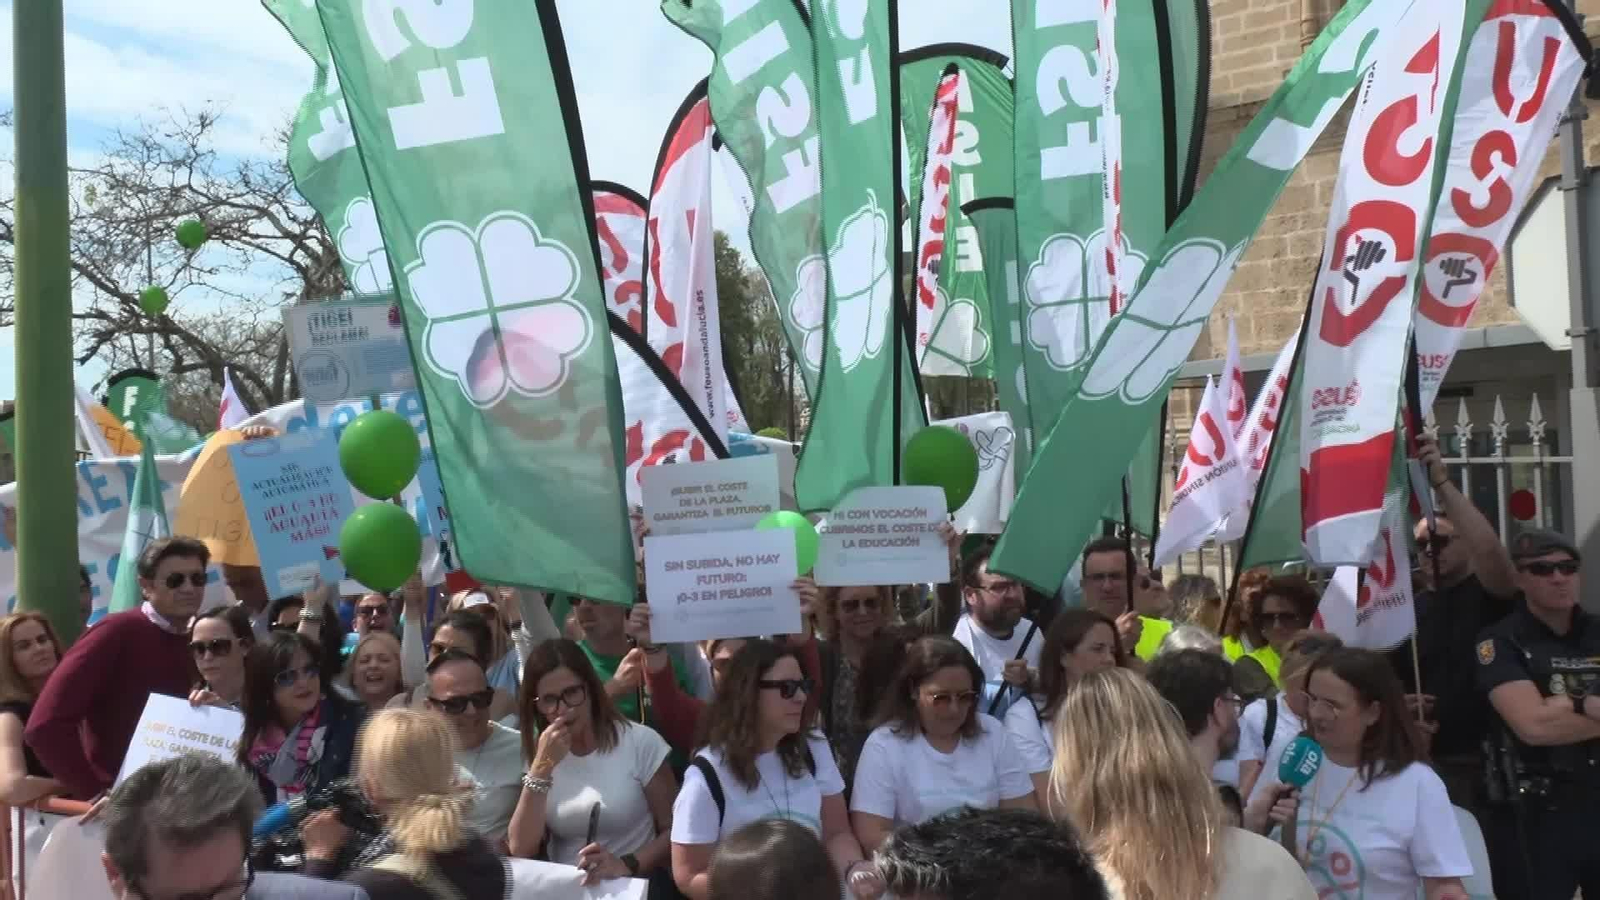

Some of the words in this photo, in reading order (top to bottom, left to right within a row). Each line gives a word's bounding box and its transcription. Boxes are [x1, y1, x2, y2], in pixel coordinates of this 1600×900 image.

[717, 481, 748, 492] COSTE
[680, 498, 692, 507] DE
[694, 497, 707, 506] LA
[653, 509, 709, 521] GARANTIZA
[713, 508, 725, 517] EL
[847, 509, 871, 520] CON
[872, 506, 927, 519] VOCACIÓN
[819, 522, 875, 535] CUBRIMOS
[877, 522, 890, 534] EL
[892, 522, 927, 534] COSTE
[842, 539, 856, 549] LA
[858, 536, 920, 549] EDUCACIÓN
[664, 560, 684, 572] SIN
[735, 555, 754, 567] NO
[756, 553, 781, 566] HAY
[702, 590, 717, 601] EN
